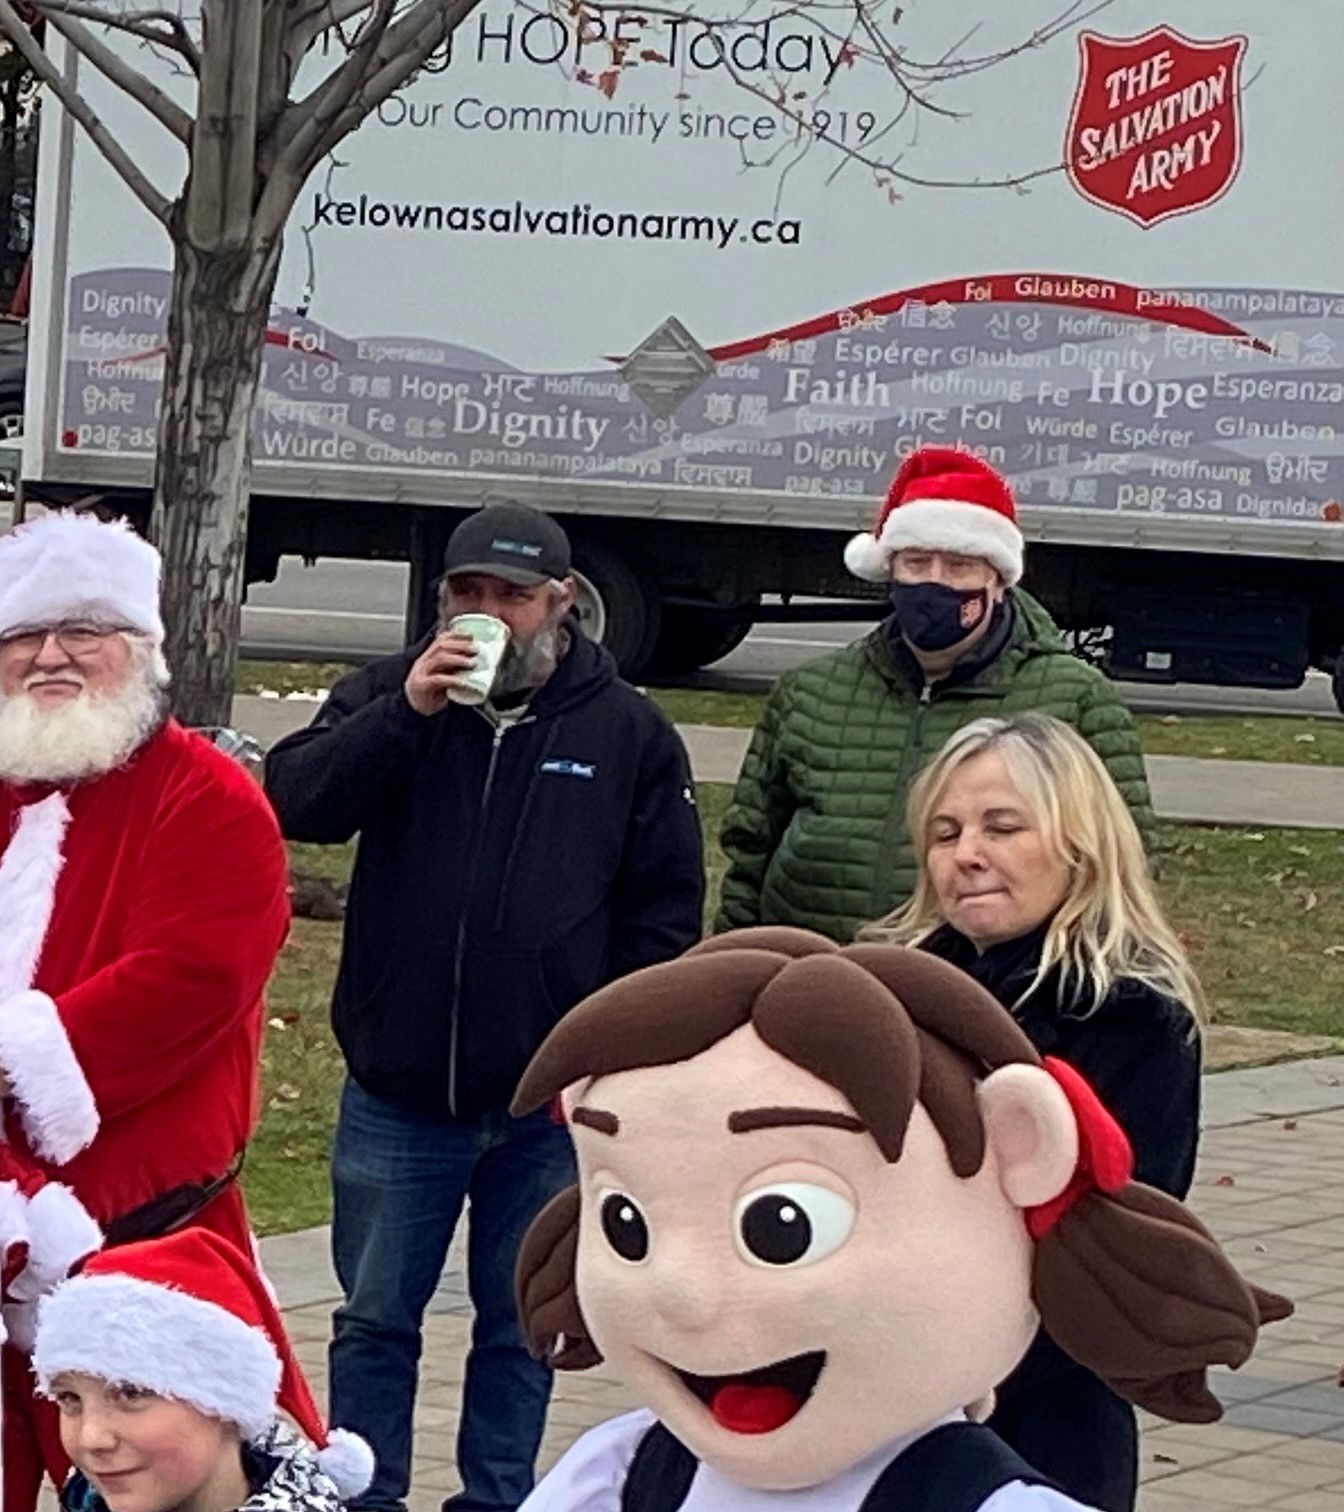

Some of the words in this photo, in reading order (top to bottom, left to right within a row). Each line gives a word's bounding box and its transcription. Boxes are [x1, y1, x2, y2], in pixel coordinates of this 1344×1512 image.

[477, 13, 642, 66] HOPE
[663, 18, 847, 86] Today
[1106, 50, 1175, 109] THE
[378, 95, 443, 127] Our
[454, 97, 669, 142] Community
[679, 105, 776, 140] since
[796, 110, 876, 142] 1919
[1078, 64, 1227, 170] SALVATION
[1126, 119, 1222, 199] ARMY
[314, 195, 801, 248] kelownasalvationarmy.ca
[965, 281, 992, 301] Foi
[1015, 276, 1116, 299] Glauben
[83, 289, 166, 319] Dignity
[288, 326, 325, 351] Foi
[986, 312, 1040, 341] 신앙
[1058, 314, 1152, 343] Hoffnung
[87, 360, 163, 380] Hoffnu
[834, 338, 945, 367] Espérer
[951, 346, 1051, 368] Glauben
[1060, 342, 1154, 374] Dignity
[282, 360, 344, 393] 신앙
[401, 375, 469, 404] Hope
[545, 376, 630, 402] Hoffnung
[783, 367, 891, 408] Faith
[912, 371, 1023, 403] Hoffnung
[1037, 381, 1070, 407] Fe
[1088, 368, 1207, 419] Hope
[1213, 372, 1343, 404] Esperanza
[367, 407, 395, 432] Fe
[453, 400, 610, 452] Dignity
[622, 413, 680, 446] 신앙
[960, 404, 1003, 430] Foi
[79, 424, 157, 451] pag-as
[262, 429, 356, 460] Würde
[366, 443, 458, 465] Glauben
[681, 432, 783, 458] Esperanza
[1026, 416, 1097, 438] Würde
[1110, 421, 1194, 449] Espérer
[1216, 417, 1336, 441] Glauben
[794, 441, 887, 474] Dignity
[1151, 459, 1251, 486] Hoffnung
[1116, 484, 1223, 511] pag-asa
[1237, 493, 1318, 518] Dignida
